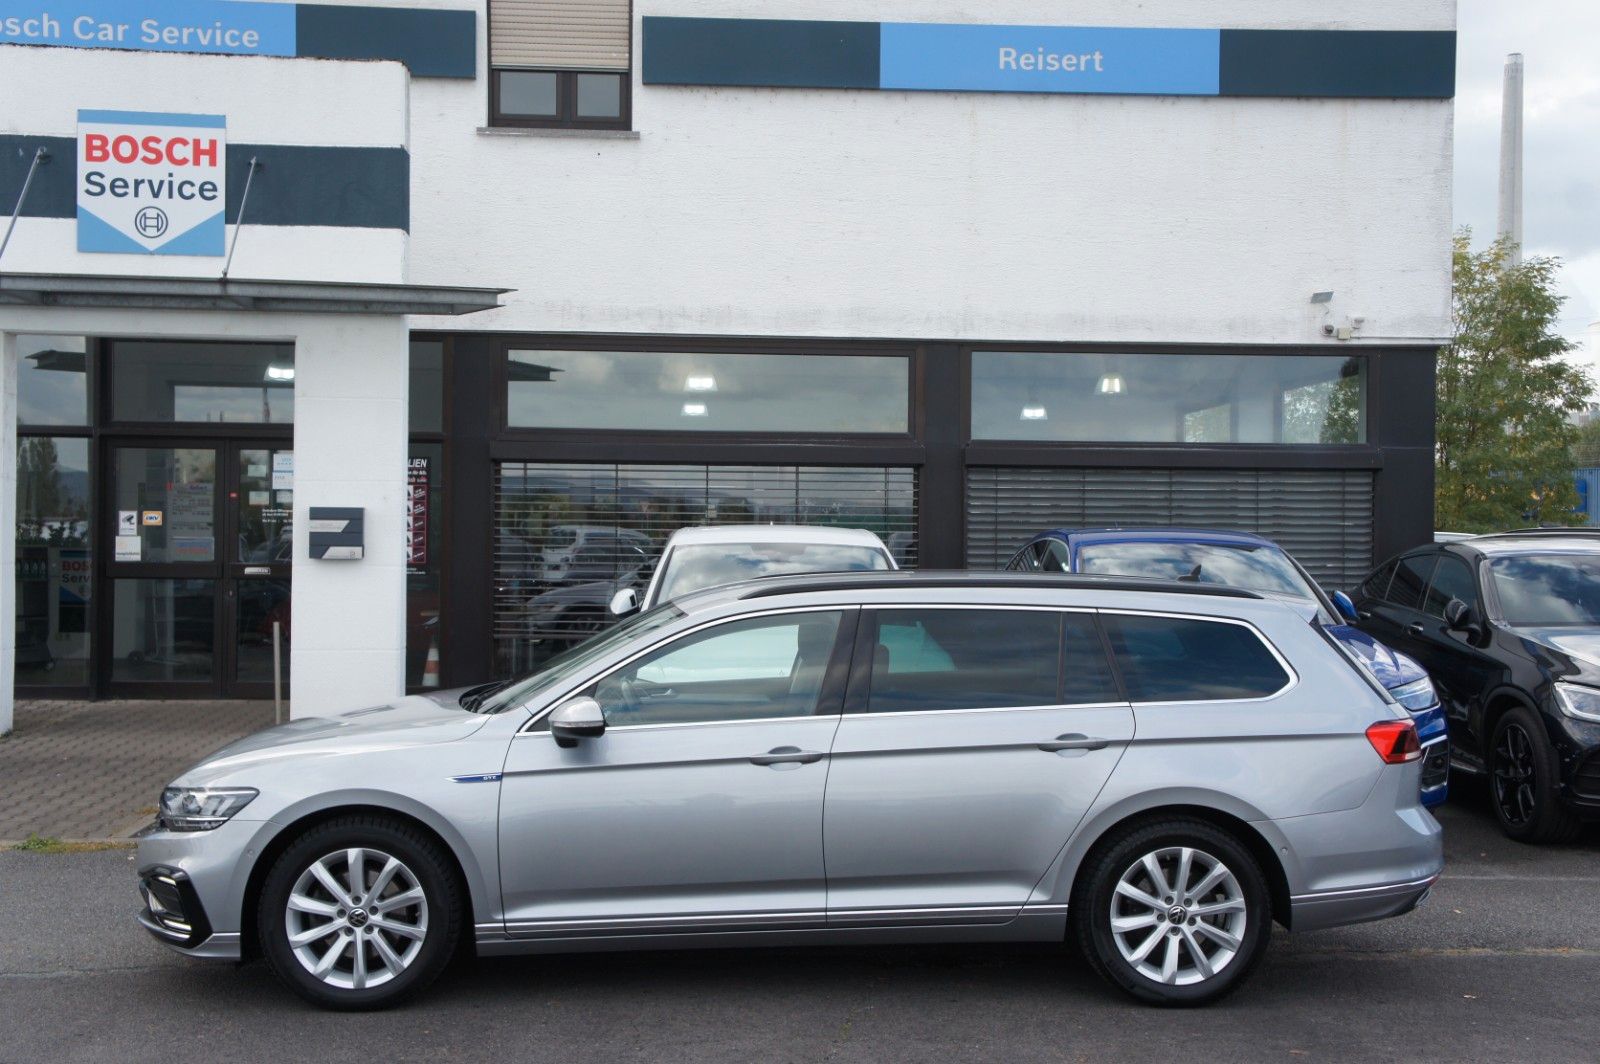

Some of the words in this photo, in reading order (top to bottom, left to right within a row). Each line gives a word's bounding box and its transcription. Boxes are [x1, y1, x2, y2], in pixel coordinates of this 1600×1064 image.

[0, 13, 60, 38] sch
[73, 15, 128, 41] Car
[141, 19, 259, 48] Service
[999, 47, 1104, 72] Reisert
[85, 133, 217, 167] BOSCH
[84, 171, 218, 201] Service
